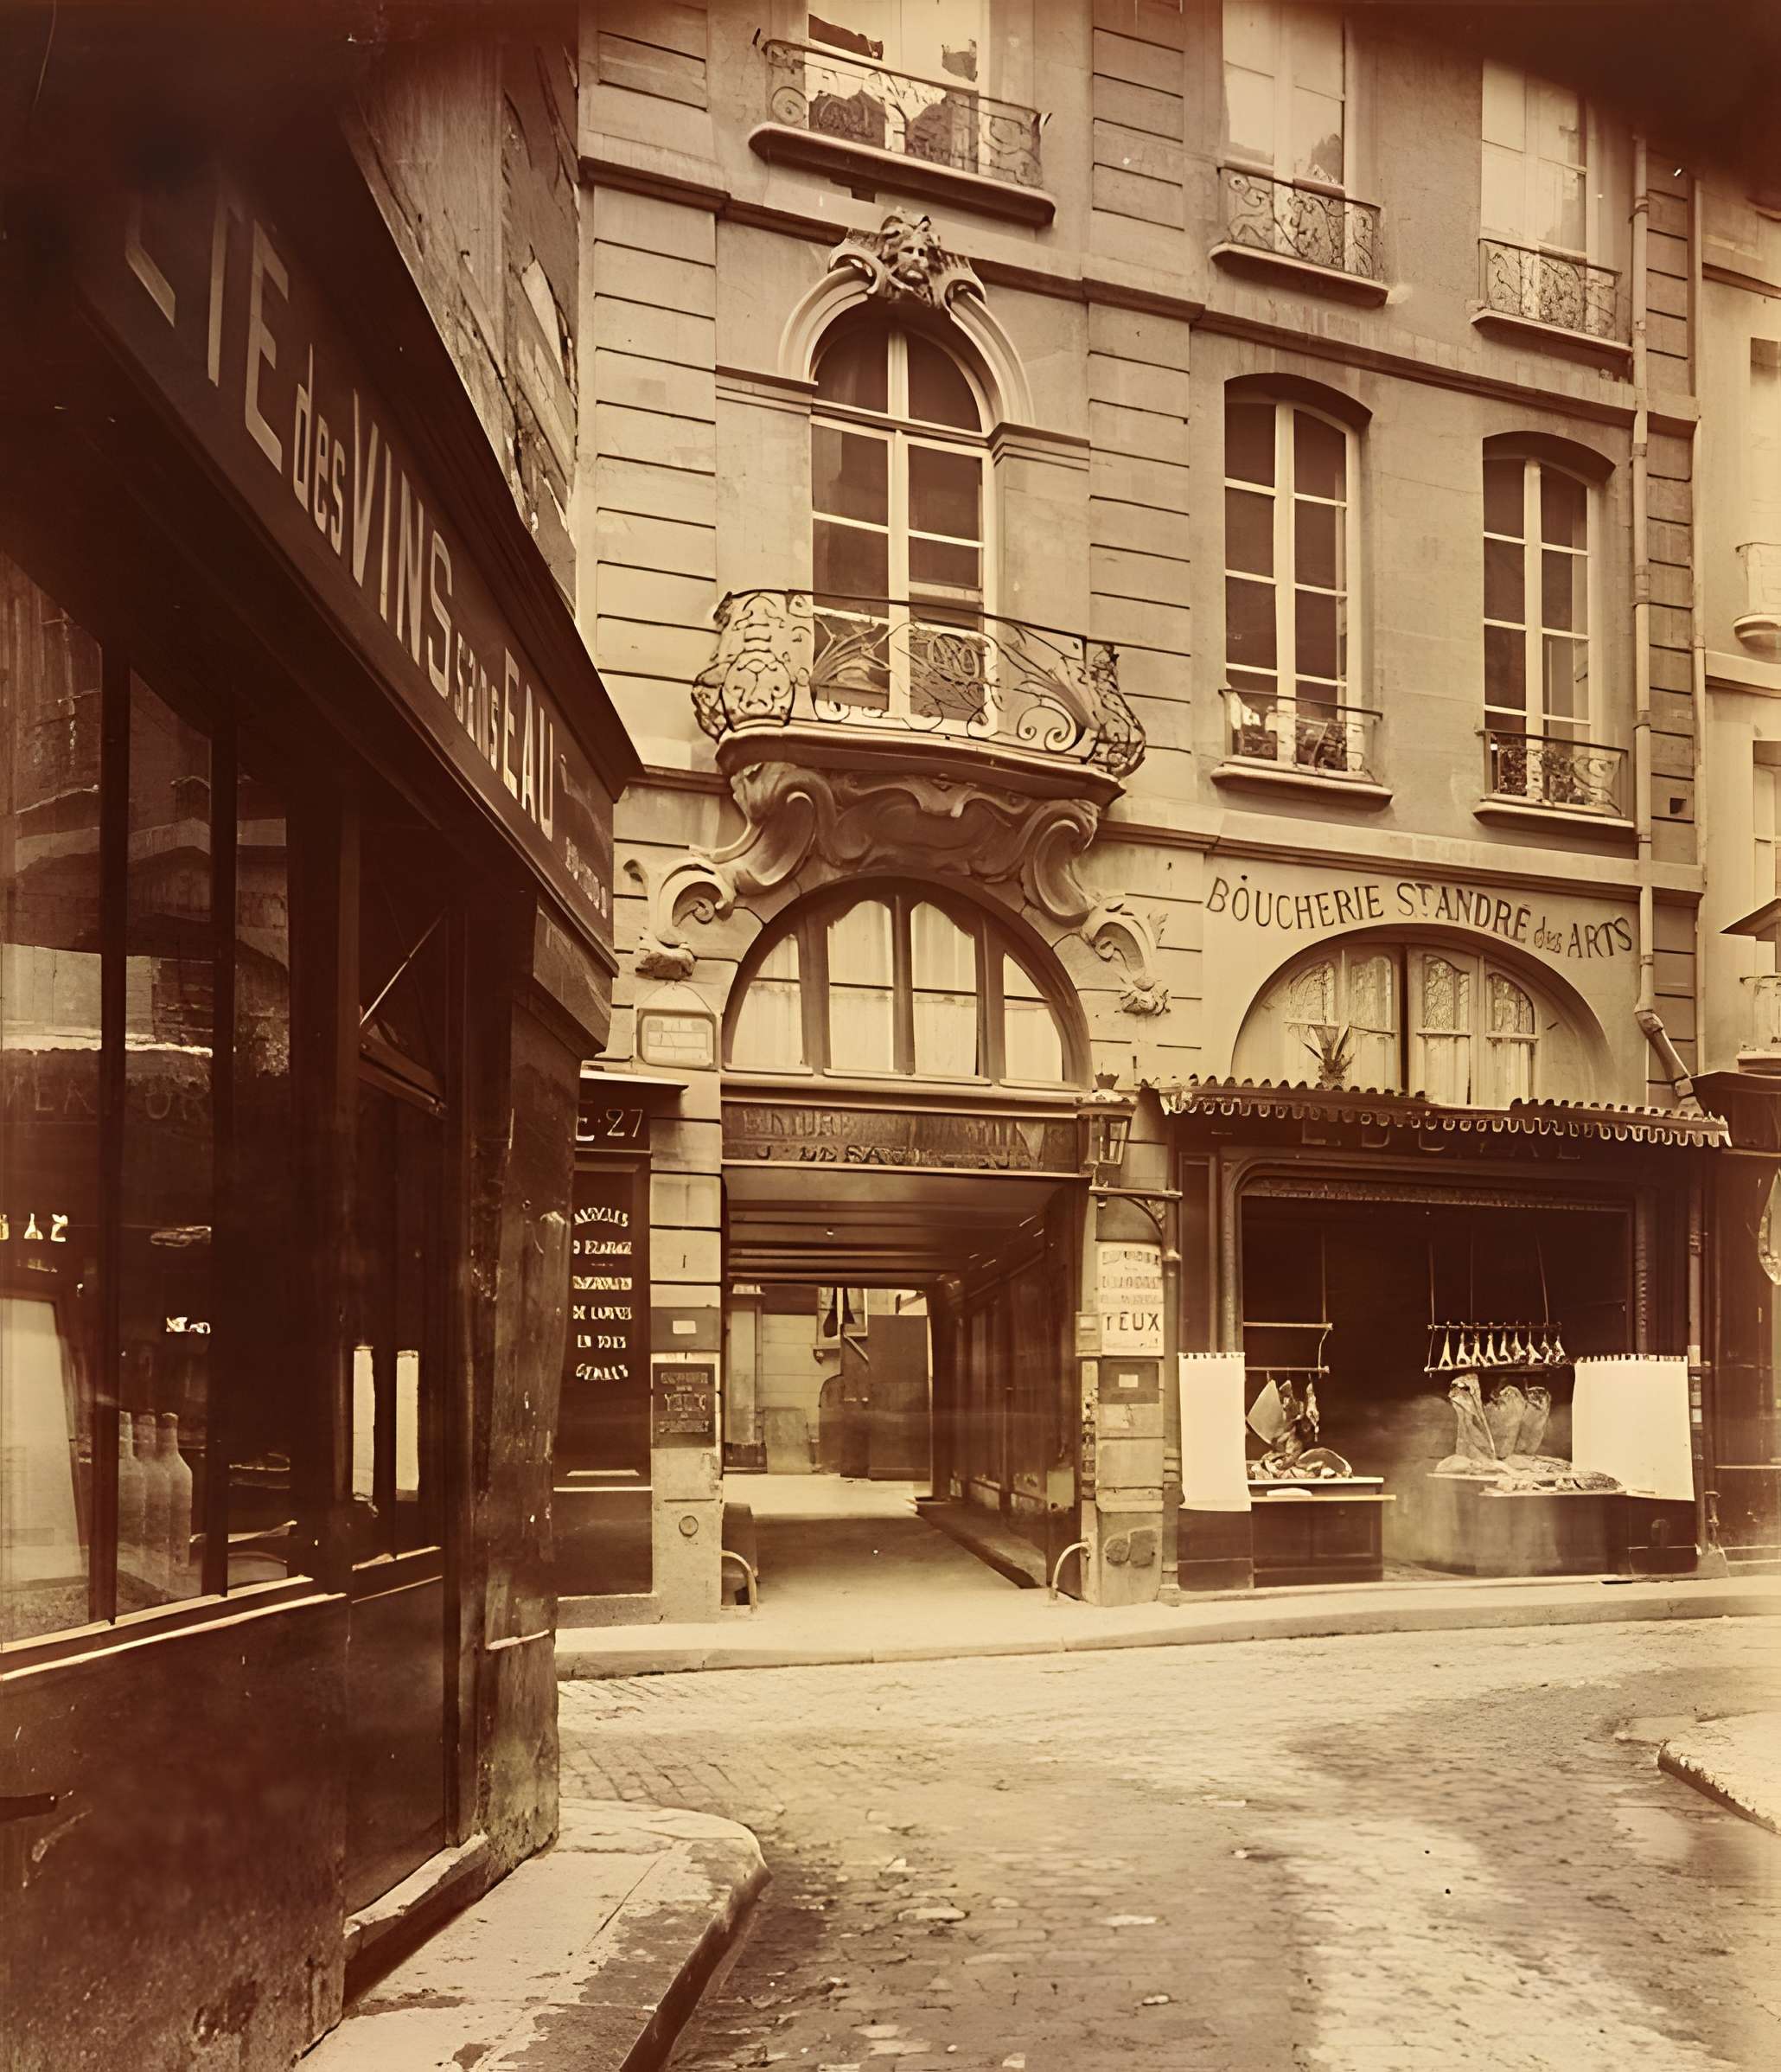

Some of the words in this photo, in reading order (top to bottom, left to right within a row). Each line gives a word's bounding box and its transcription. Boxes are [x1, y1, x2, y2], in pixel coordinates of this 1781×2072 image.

[293, 343, 346, 556] des
[352, 389, 453, 700] VINS
[1567, 917, 1633, 958] ARTS
[606, 1109, 643, 1138] 27
